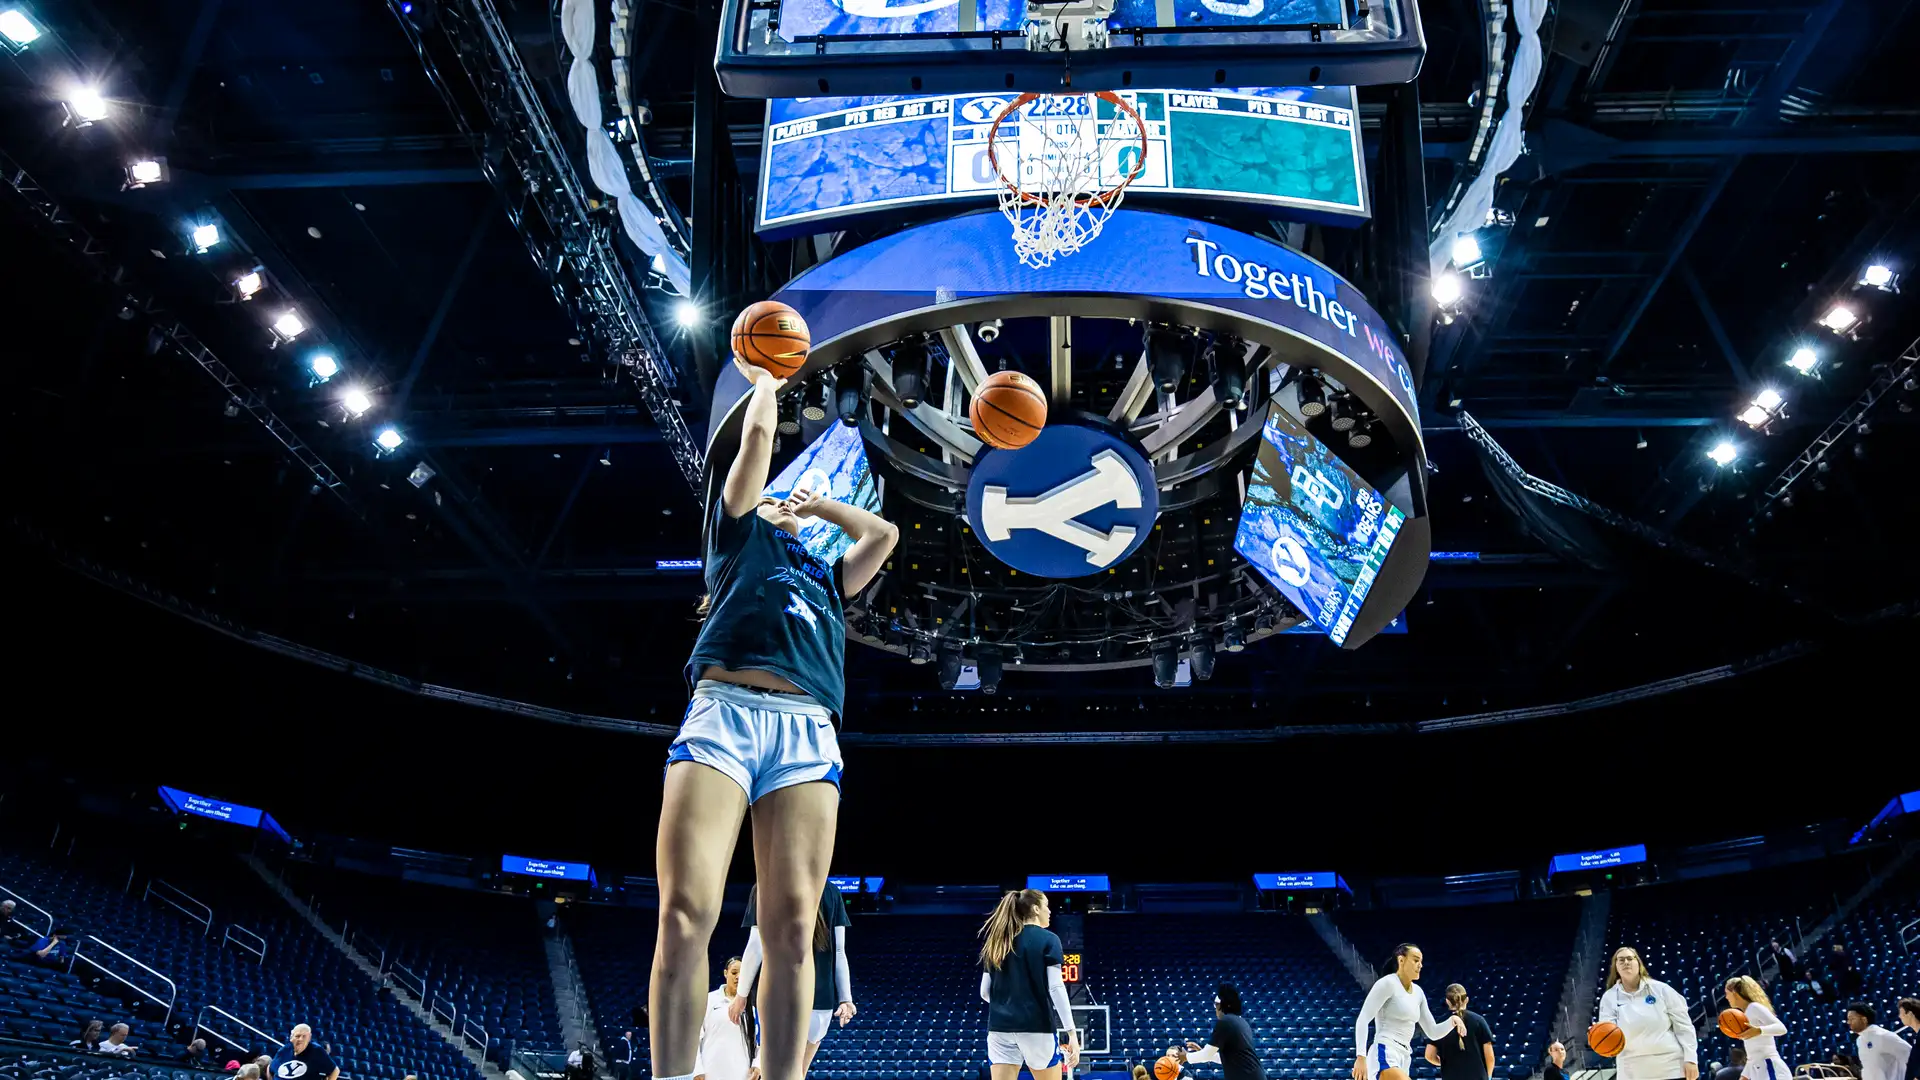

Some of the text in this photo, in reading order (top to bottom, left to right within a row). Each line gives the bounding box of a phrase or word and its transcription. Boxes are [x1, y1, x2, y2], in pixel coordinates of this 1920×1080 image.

[844, 100, 948, 126] PTS REB AST PF
[1027, 96, 1090, 116] 22:28
[1172, 94, 1219, 109] PLAYER
[1247, 100, 1348, 124] PTS REB AST PF
[776, 120, 818, 140] PLAYER
[1056, 124, 1077, 135] QTR
[972, 149, 999, 184] 0
[1027, 165, 1033, 175] 0
[1118, 145, 1147, 180] 0
[1185, 236, 1358, 337] Together
[981, 449, 1142, 568] Y
[1358, 496, 1383, 537] BEARS
[802, 563, 825, 579] BIG
[1317, 586, 1342, 628] COUGARS
[284, 1062, 304, 1076] Y
